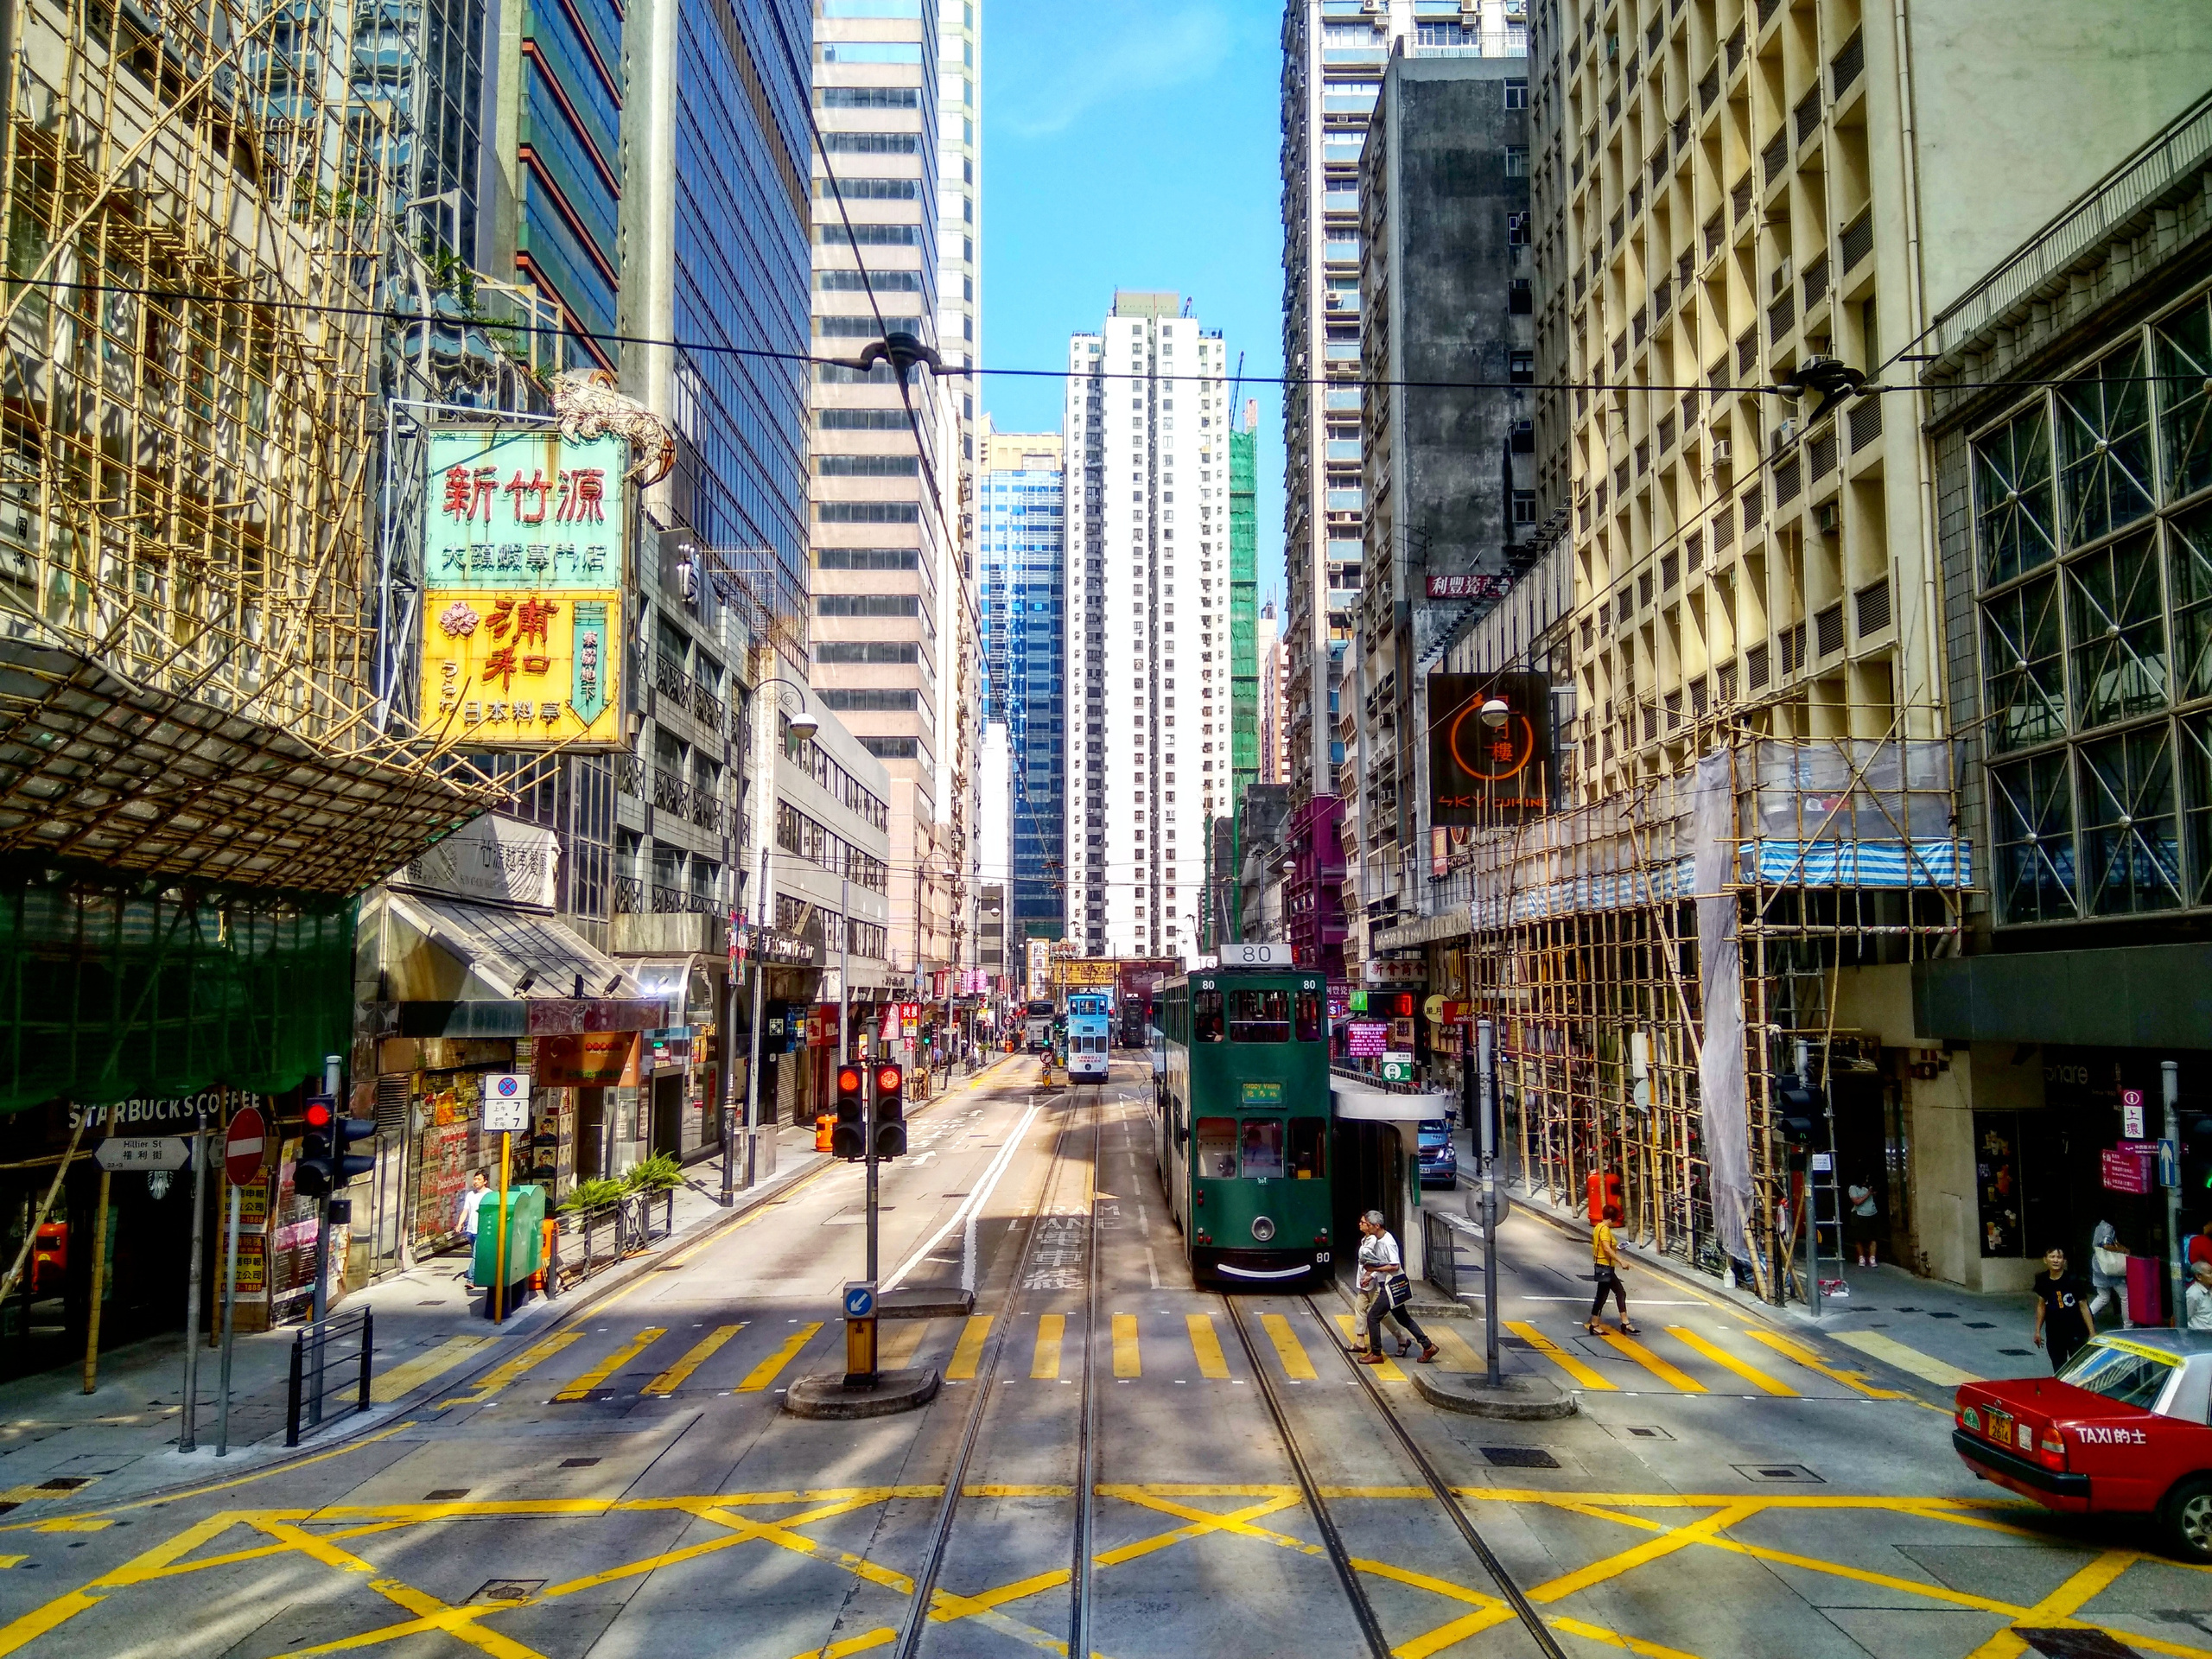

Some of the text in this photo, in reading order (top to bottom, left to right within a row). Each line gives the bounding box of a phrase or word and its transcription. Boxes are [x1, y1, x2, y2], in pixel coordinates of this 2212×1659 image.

[442, 464, 607, 525] 新竹源
[464, 698, 562, 728] 日本料亭
[1438, 795, 1487, 808] SKY
[1243, 946, 1271, 963] 80
[1198, 957, 1215, 969] 16
[1202, 980, 1216, 990] 80
[1303, 980, 1316, 990] 80
[69, 1095, 194, 1128] STARBUCKS
[513, 1102, 521, 1112] 7
[512, 1117, 520, 1128] 7
[2126, 1109, 2140, 1135] 上環
[124, 1140, 162, 1149] Hillier St
[1019, 1205, 1122, 1217] TRAM
[1317, 1252, 1331, 1262] 80
[1992, 1426, 2009, 1441] 2614
[2075, 1427, 2146, 1445] TAXI 的士
